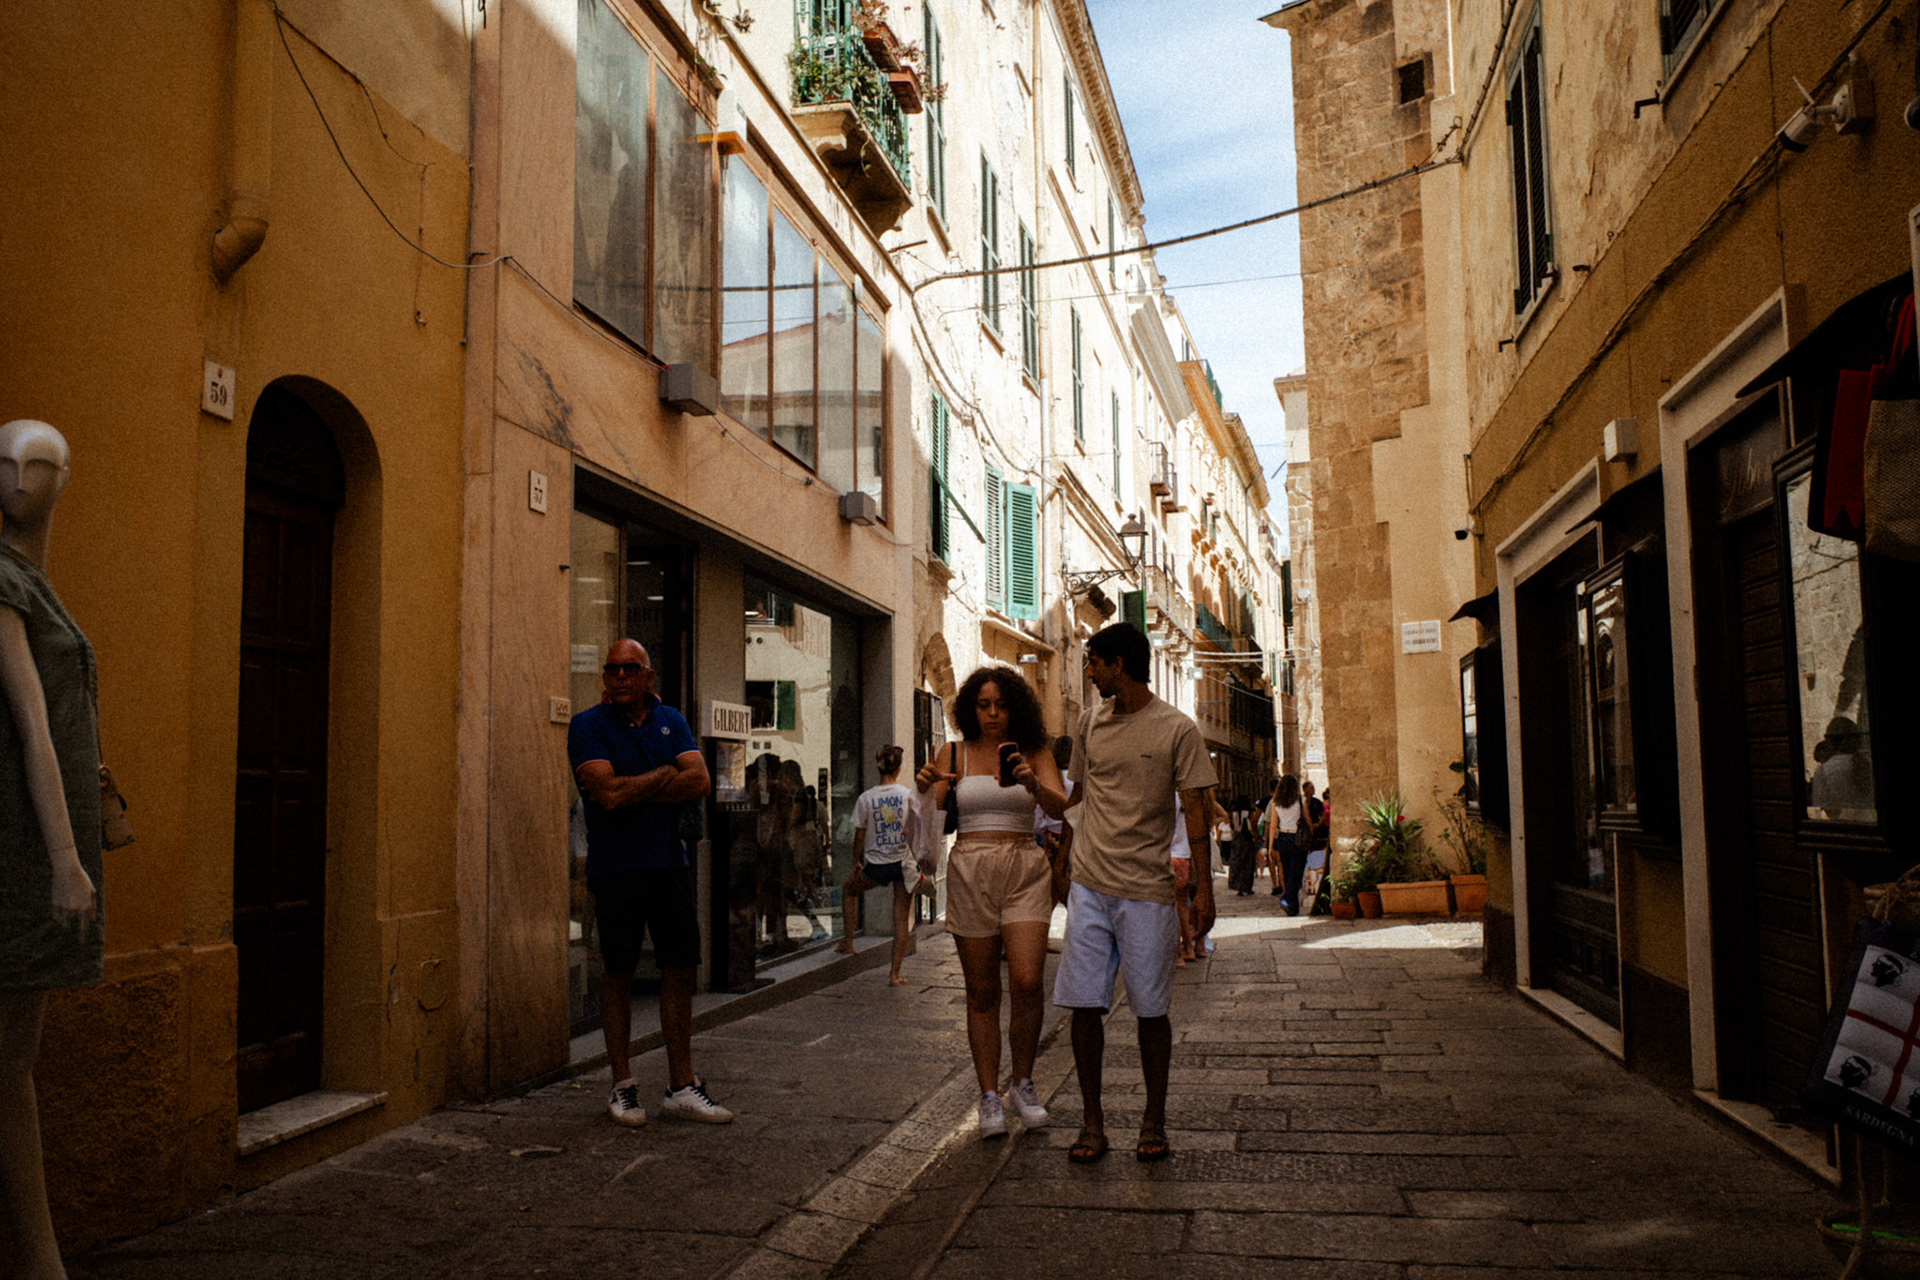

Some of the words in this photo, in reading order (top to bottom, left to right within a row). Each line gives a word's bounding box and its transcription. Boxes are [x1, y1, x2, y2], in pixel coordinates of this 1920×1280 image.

[210, 381, 227, 406] 59
[533, 486, 543, 504] 57
[714, 707, 749, 734] GILBERT
[872, 796, 903, 809] LIMON
[875, 821, 903, 834] LIMON
[876, 832, 906, 846] CELLO
[1845, 1105, 1914, 1147] SARDEGNA
